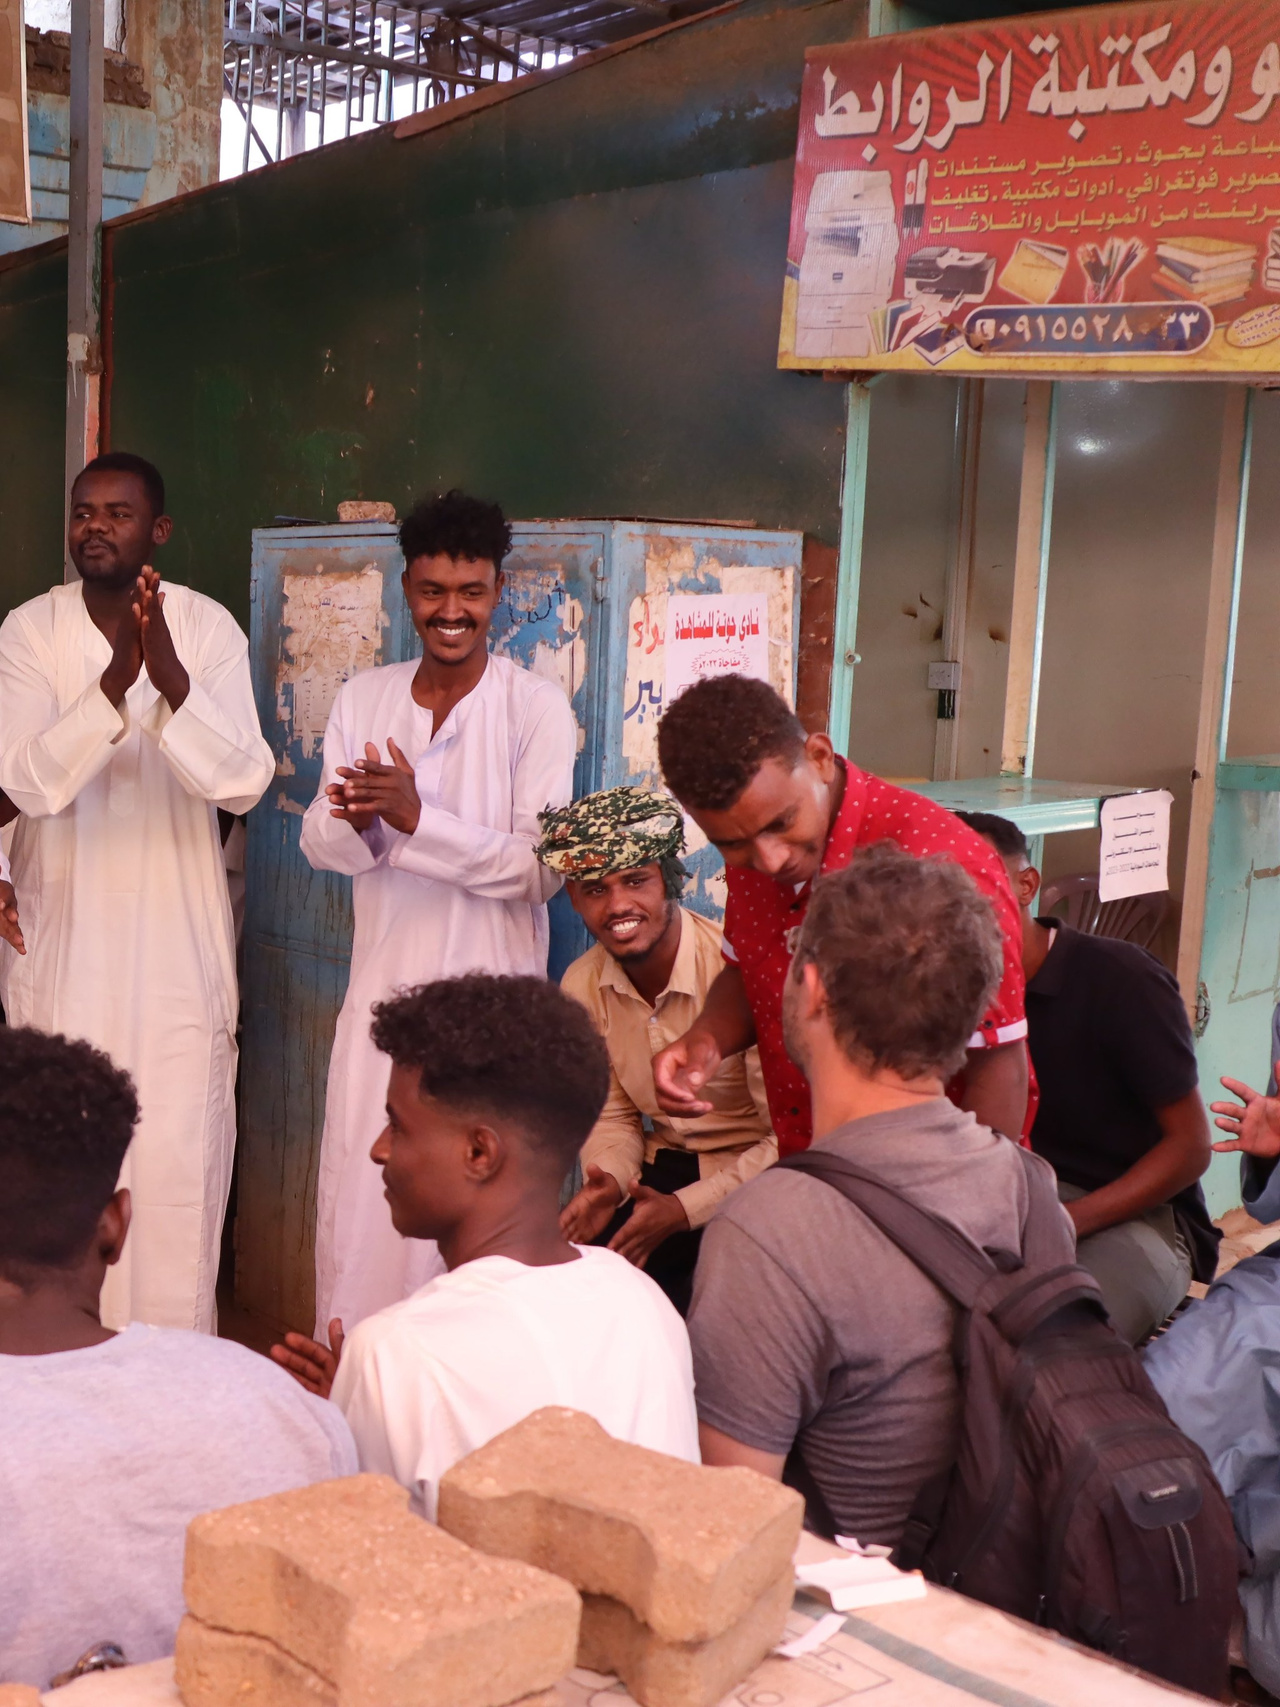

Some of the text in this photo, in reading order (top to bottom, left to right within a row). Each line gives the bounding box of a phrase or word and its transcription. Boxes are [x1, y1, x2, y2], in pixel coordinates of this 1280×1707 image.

[1027, 22, 1232, 140] ومكتبة
[815, 49, 1012, 162] الروابط
[1030, 145, 1123, 176] تصوير
[1211, 134, 1280, 159] باعة
[933, 156, 1027, 178] مستندات
[1220, 171, 1280, 194] صوير
[930, 184, 990, 210] تغليف
[928, 199, 1280, 235] رينت من الموبايل والفلاشات
[674, 610, 714, 641] للمشاهدة
[739, 606, 760, 650] نادي
